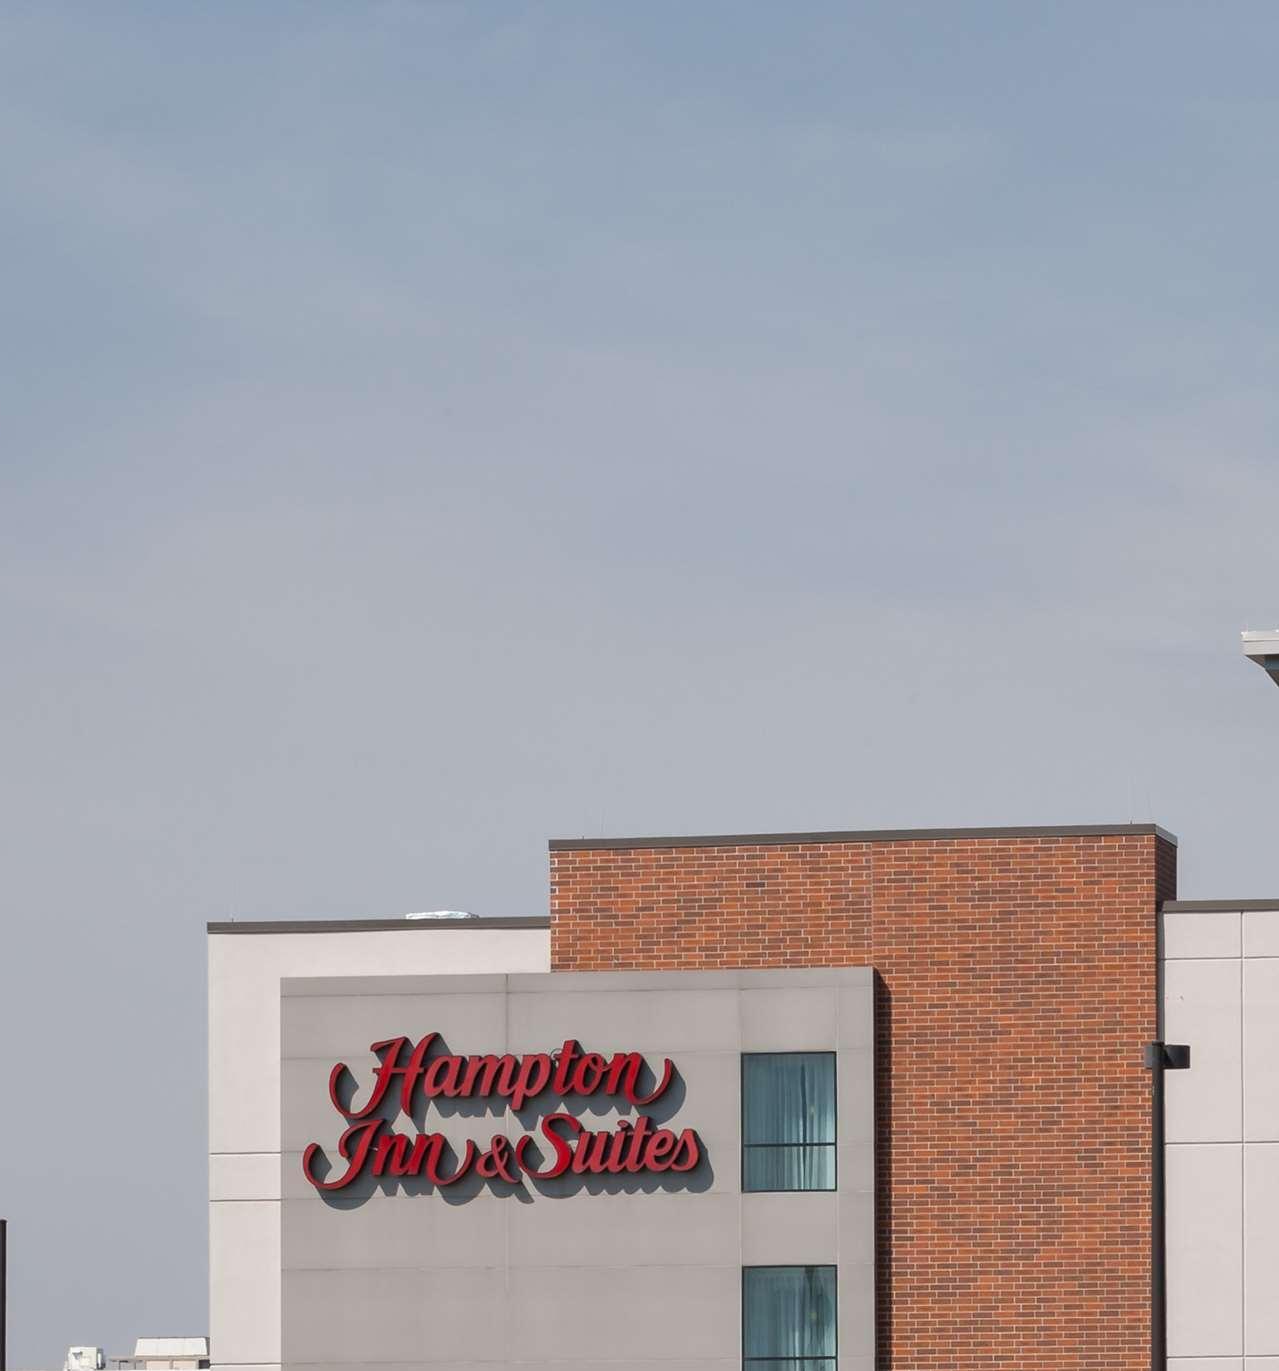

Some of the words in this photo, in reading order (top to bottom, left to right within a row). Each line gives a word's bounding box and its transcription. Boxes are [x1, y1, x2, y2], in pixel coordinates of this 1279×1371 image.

[329, 1032, 671, 1119] Hampton
[303, 1119, 473, 1190] Inn
[476, 1134, 521, 1184] &
[517, 1112, 698, 1180] Suites
